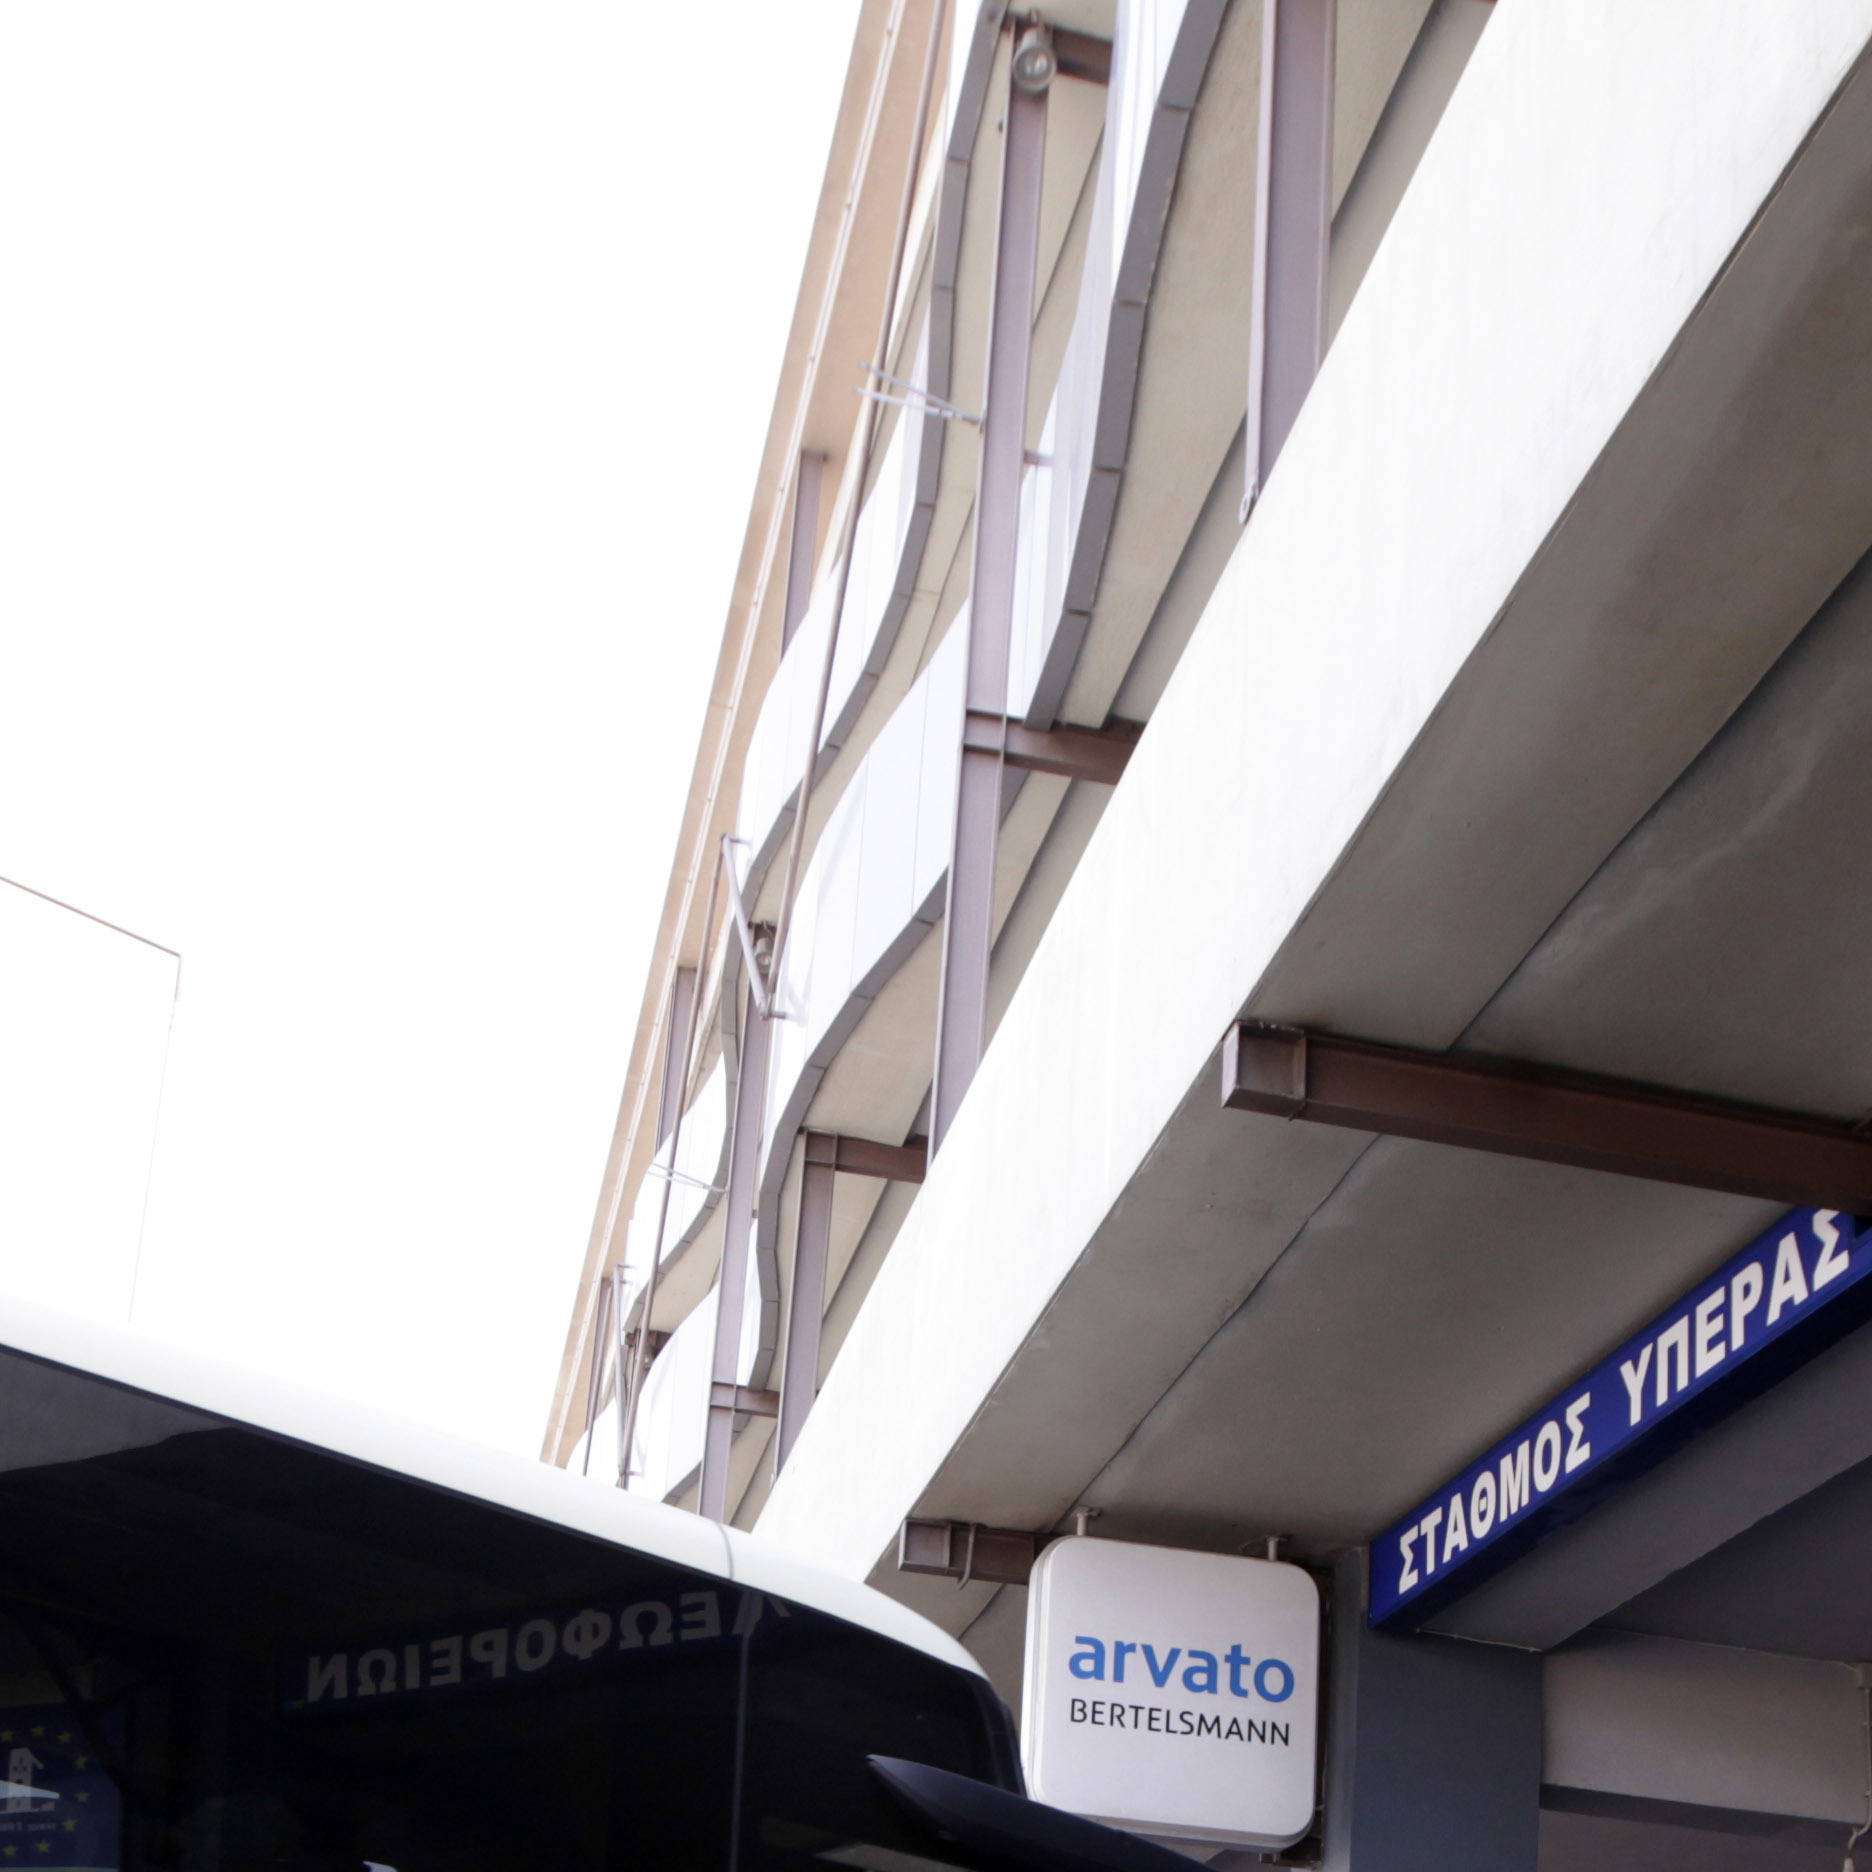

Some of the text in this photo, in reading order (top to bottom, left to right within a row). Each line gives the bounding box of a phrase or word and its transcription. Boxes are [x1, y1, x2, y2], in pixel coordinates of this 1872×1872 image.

[1397, 1391, 1591, 1595] ΣΤΑΘΜΟΣ
[1068, 1636, 1295, 1703] arvato
[1070, 1698, 1290, 1747] BERTELSMANN
